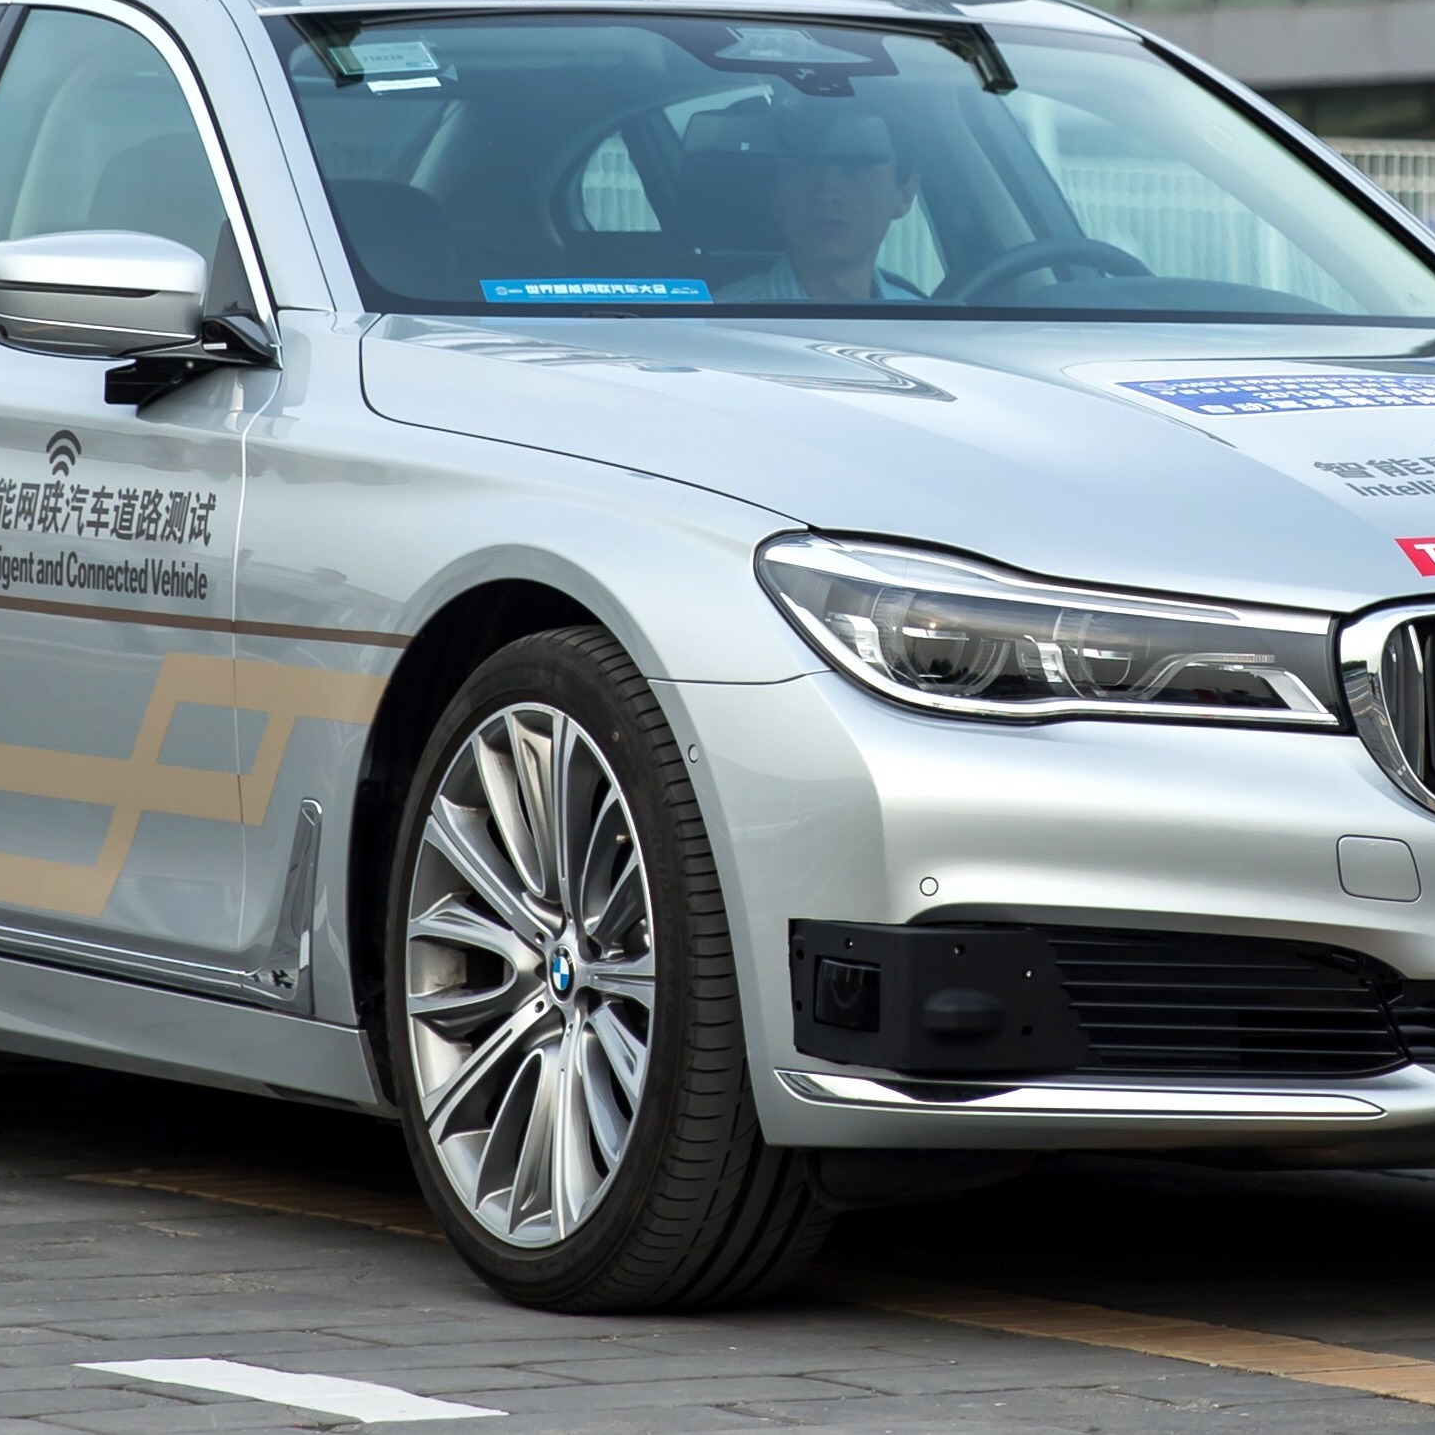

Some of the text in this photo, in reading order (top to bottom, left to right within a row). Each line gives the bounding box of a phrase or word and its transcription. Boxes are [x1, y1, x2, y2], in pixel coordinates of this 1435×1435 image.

[36, 552, 64, 587] and
[67, 552, 149, 595] Connected
[151, 558, 208, 601] Vehicle
